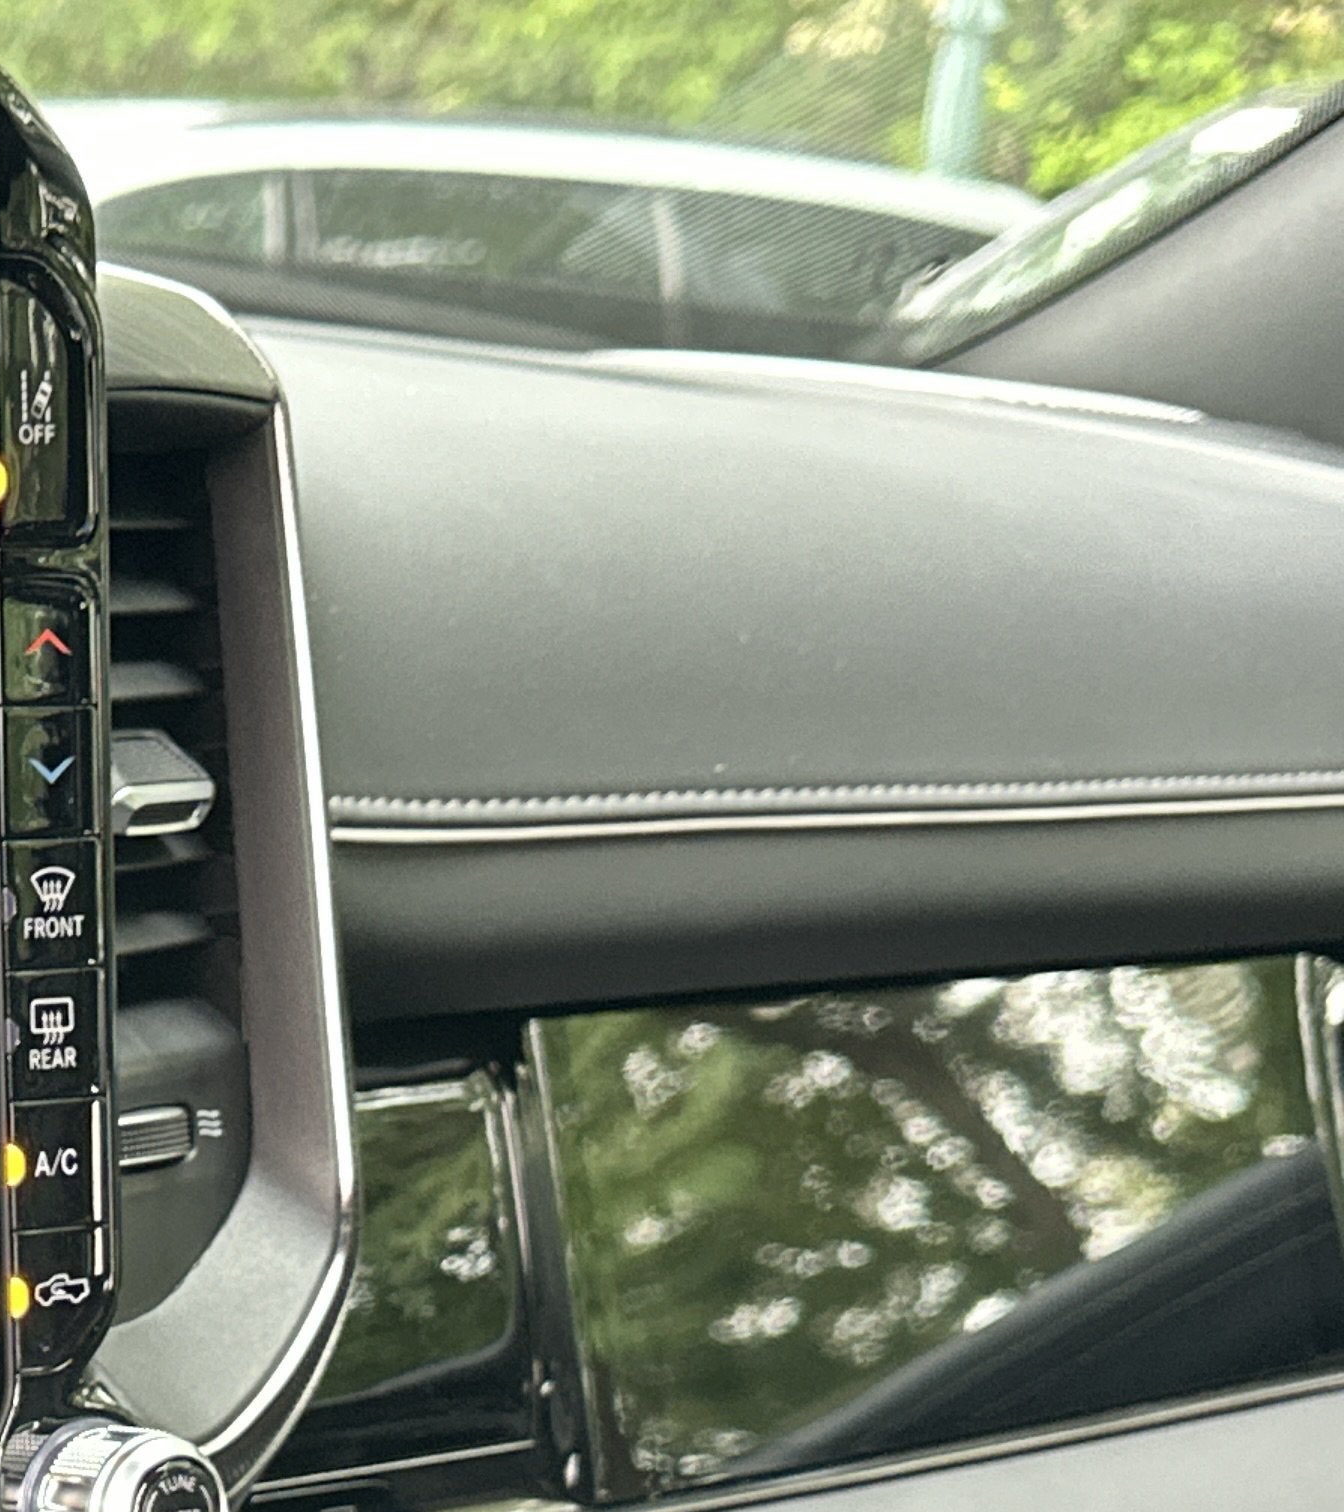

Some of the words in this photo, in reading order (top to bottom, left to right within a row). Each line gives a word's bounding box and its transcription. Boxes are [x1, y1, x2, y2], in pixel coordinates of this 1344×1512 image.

[18, 423, 56, 445] OFF
[23, 914, 85, 940] FRONT
[28, 1046, 78, 1070] REAR
[34, 1148, 79, 1178] A/C
